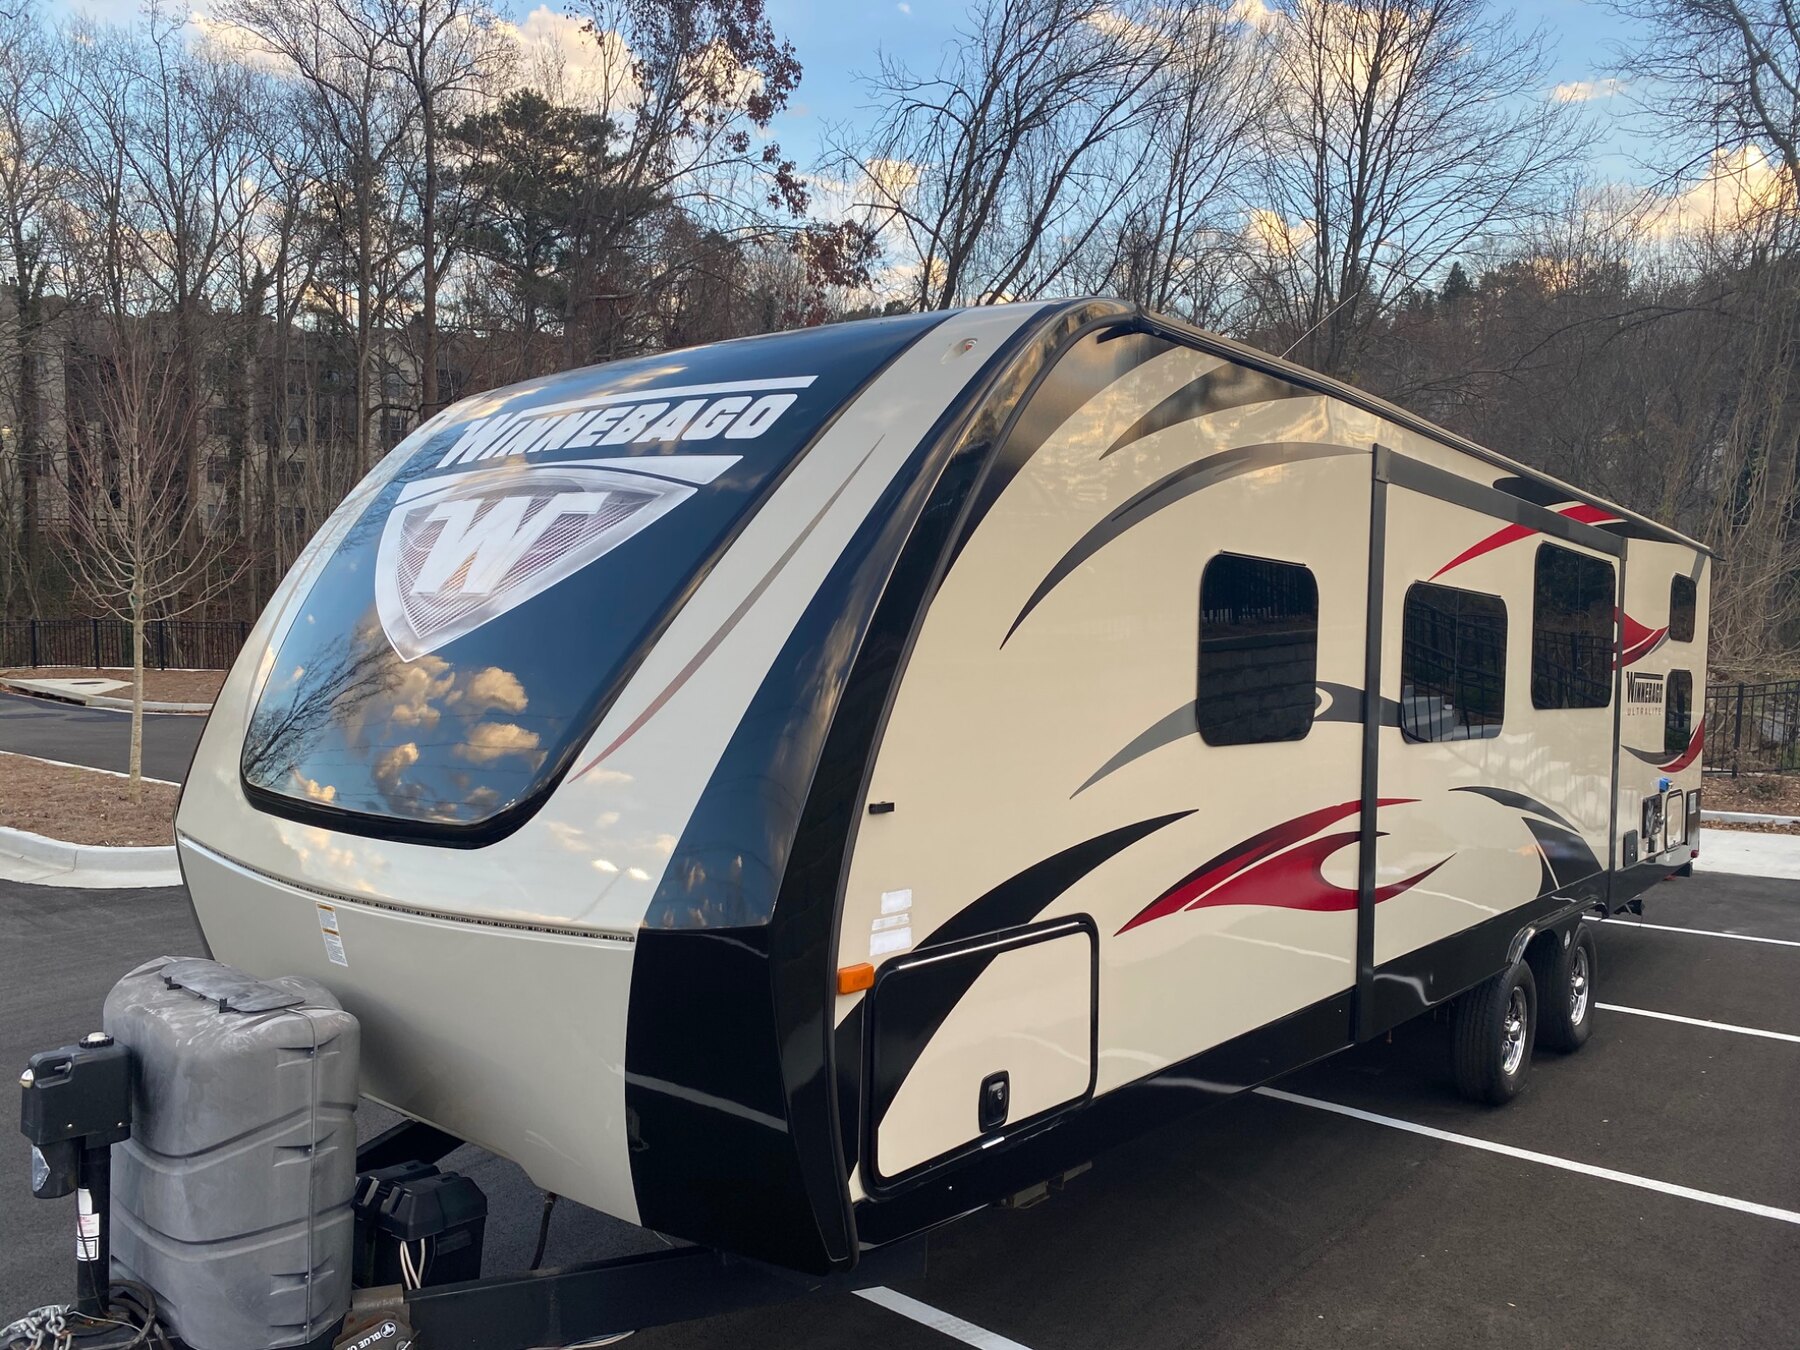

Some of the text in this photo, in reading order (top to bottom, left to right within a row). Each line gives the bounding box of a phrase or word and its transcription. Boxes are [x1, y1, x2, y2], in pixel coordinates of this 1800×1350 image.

[435, 376, 818, 469] WINNEBAGO
[409, 492, 607, 597] W
[1626, 671, 1663, 703] WINNEBAGO
[1627, 707, 1661, 716] ULTRALITE
[358, 1331, 382, 1349] BLUE
